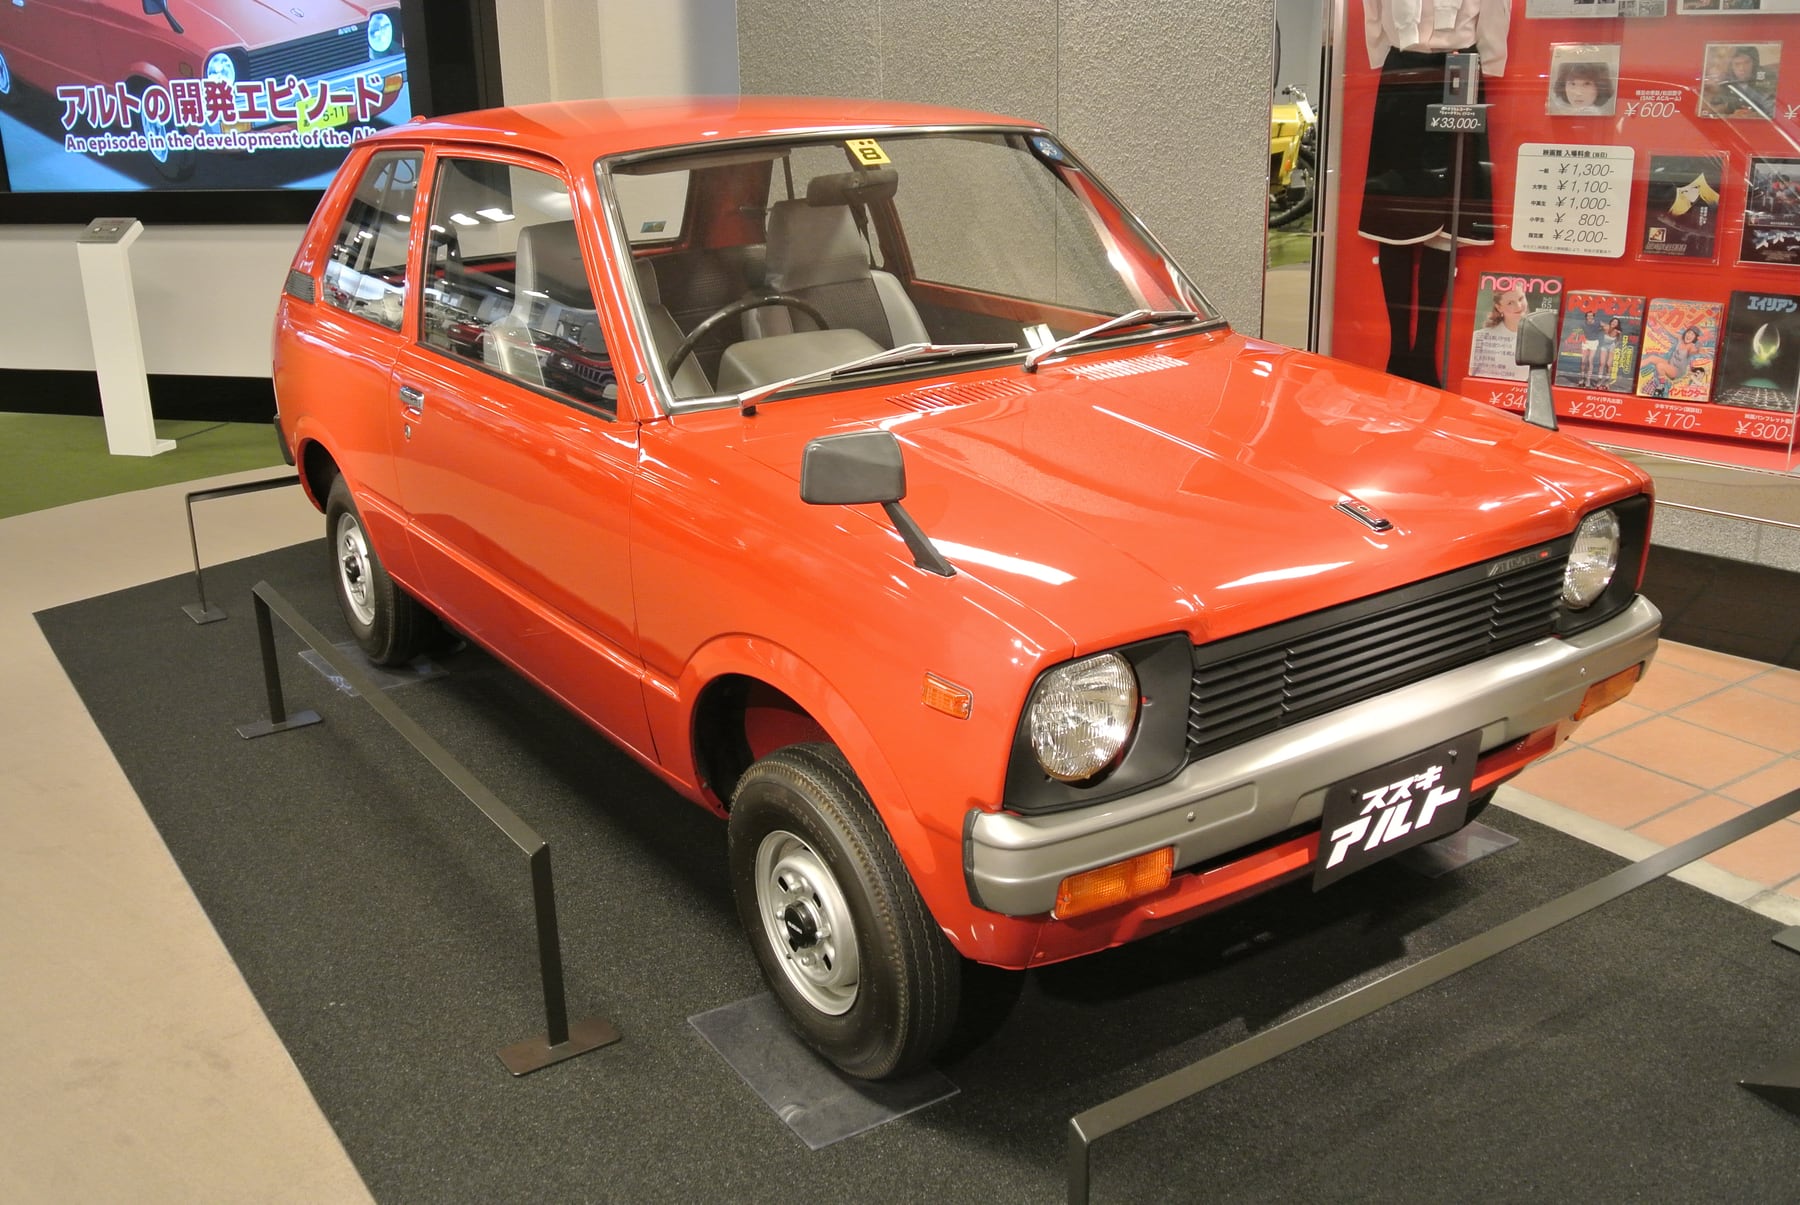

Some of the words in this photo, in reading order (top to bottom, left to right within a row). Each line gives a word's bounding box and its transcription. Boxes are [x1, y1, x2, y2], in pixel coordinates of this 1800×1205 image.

[57, 74, 384, 129] アルトの開発エピソード
[1624, 102, 1681, 118] ¥600-
[67, 135, 85, 151] An
[89, 133, 147, 154] episode
[150, 133, 165, 149] in
[168, 132, 192, 148] the
[196, 130, 299, 151] development
[303, 130, 320, 147] of
[323, 129, 350, 146] the
[1747, 296, 1798, 313] エイリアン
[1568, 401, 1622, 420] ¥230-
[1644, 410, 1702, 429] ¥170-
[1360, 765, 1443, 816] スズキ
[1325, 785, 1461, 870] アルト
